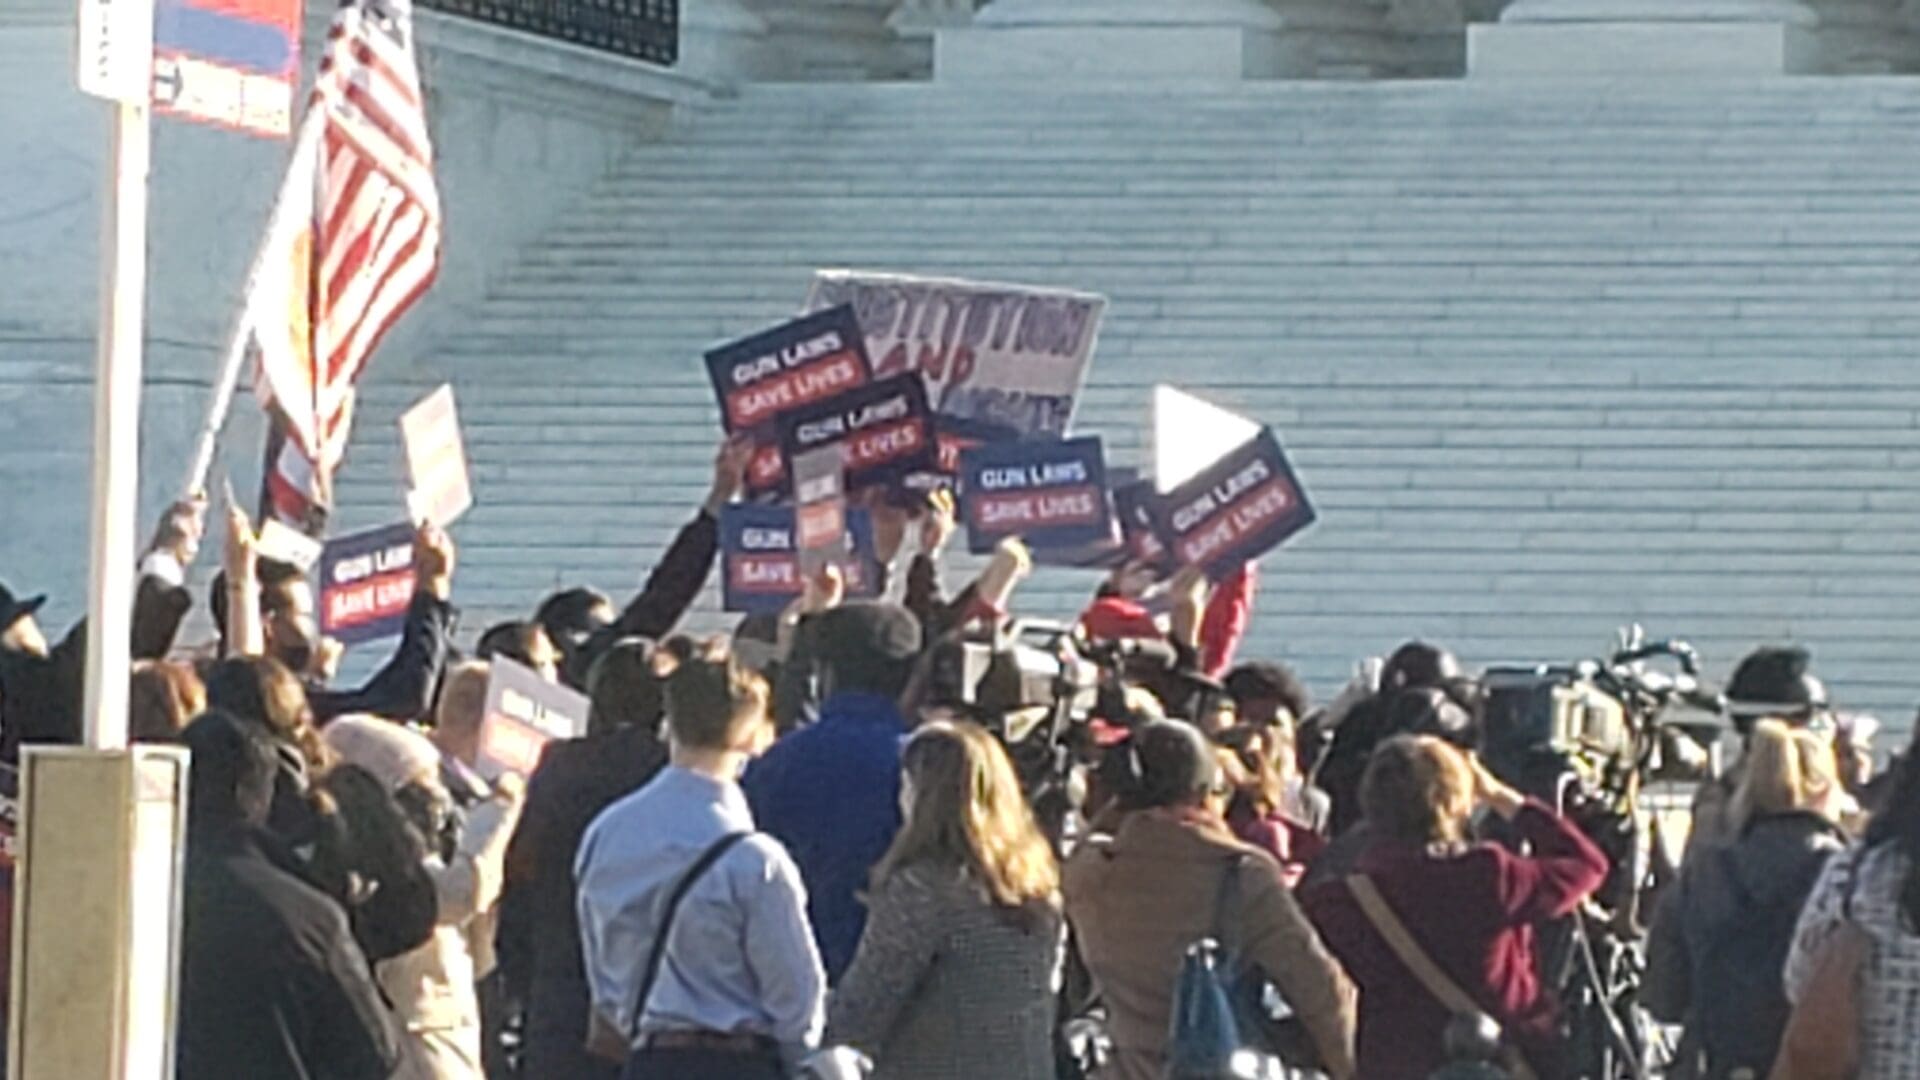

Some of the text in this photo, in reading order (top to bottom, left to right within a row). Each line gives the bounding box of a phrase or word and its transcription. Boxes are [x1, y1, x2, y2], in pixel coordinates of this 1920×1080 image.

[732, 331, 843, 385] GUN LAWS
[736, 359, 855, 417] SAVE LIVES
[796, 415, 845, 444] GUN
[847, 394, 908, 428] LAWS
[858, 425, 916, 459] LIVES
[981, 468, 1026, 488] GUN
[1030, 460, 1087, 485] LAWS
[981, 493, 1093, 522] SAVE LIVES
[1172, 493, 1217, 532] GUN
[1213, 458, 1270, 504] LAWS
[742, 527, 790, 549] GUN
[1184, 519, 1234, 562] SAVE
[1231, 485, 1287, 531] LIVES
[333, 543, 413, 583] GUN LAW
[742, 561, 794, 583] SAVE
